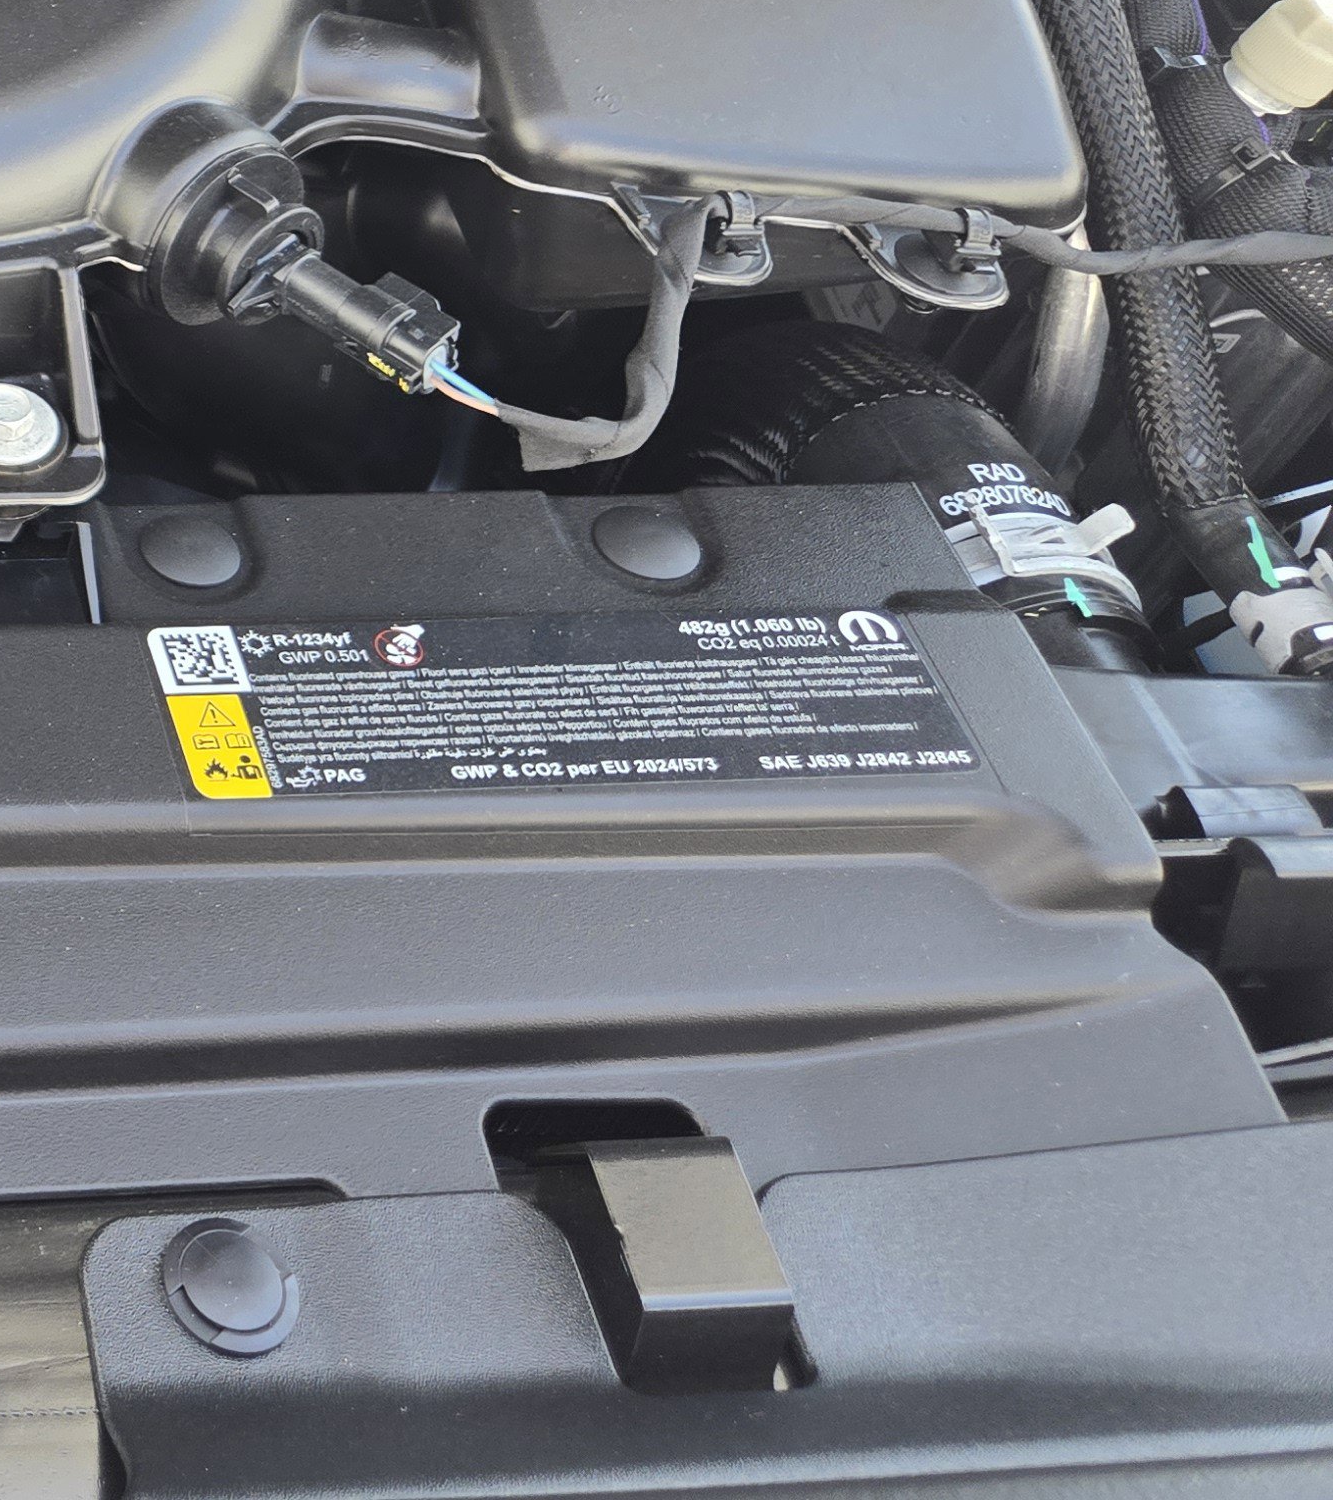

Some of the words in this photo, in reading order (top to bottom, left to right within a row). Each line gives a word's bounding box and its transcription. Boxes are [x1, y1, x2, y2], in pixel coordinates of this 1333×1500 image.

[967, 462, 1026, 483] RAD
[678, 619, 730, 636] 482g
[731, 617, 794, 637] (1.060
[796, 615, 826, 633] lb)
[273, 631, 352, 648] R-1234yf
[697, 637, 739, 651] CO2
[739, 639, 761, 652] eq
[763, 634, 828, 649] 0.00024
[830, 635, 840, 647] t
[278, 650, 321, 665] GWP
[324, 649, 369, 663] 0.501
[450, 763, 498, 780] GWP
[502, 762, 519, 778] &
[521, 761, 564, 777] CO2
[566, 762, 599, 779] per
[600, 760, 630, 775] EU
[633, 757, 719, 774] 2024/573
[758, 754, 801, 770] SAE
[806, 753, 851, 769] J639
[855, 751, 913, 767] J2842
[915, 749, 972, 766] J2845
[324, 767, 367, 783] PAG
